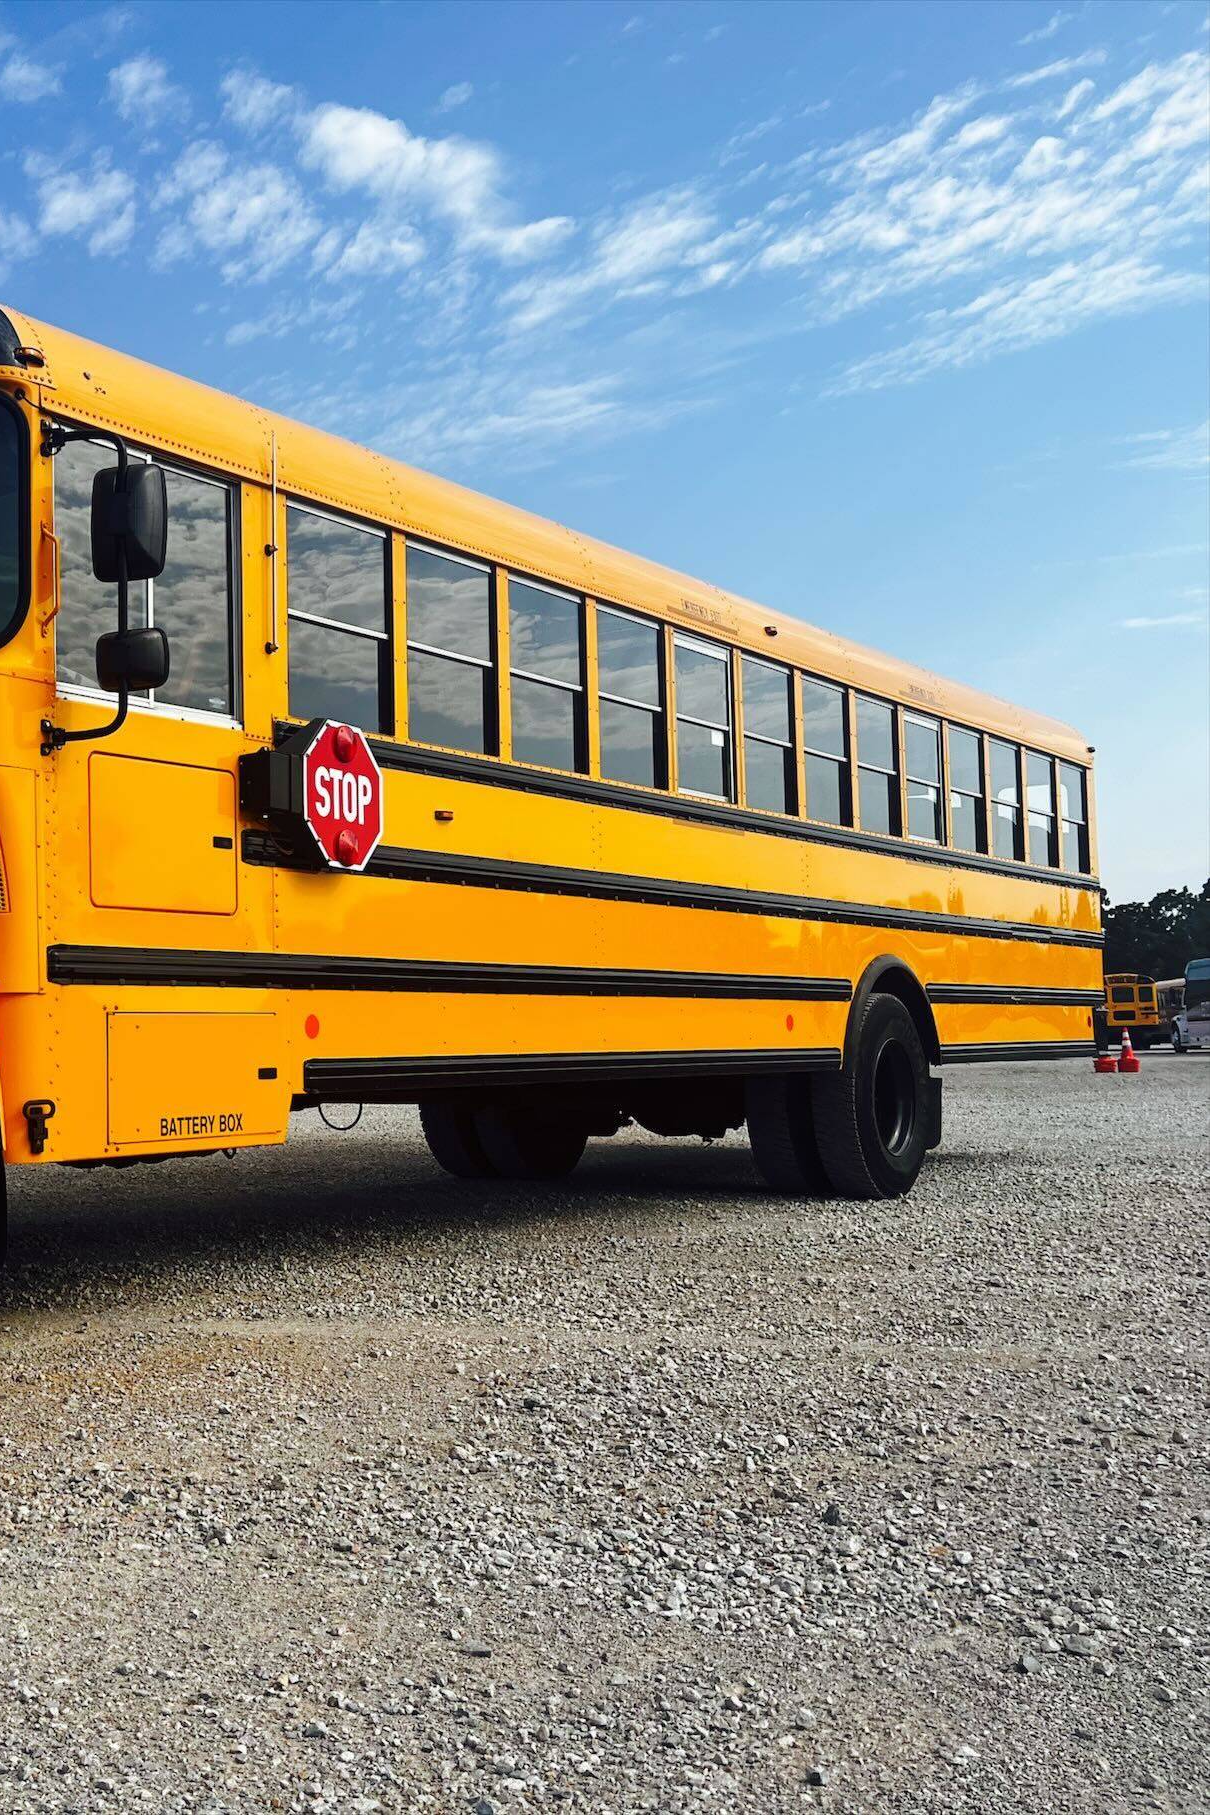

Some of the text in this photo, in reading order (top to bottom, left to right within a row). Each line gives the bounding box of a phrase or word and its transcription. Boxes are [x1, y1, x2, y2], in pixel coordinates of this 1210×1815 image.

[315, 766, 372, 825] STOP
[160, 1113, 243, 1136] BATTERY BOX
